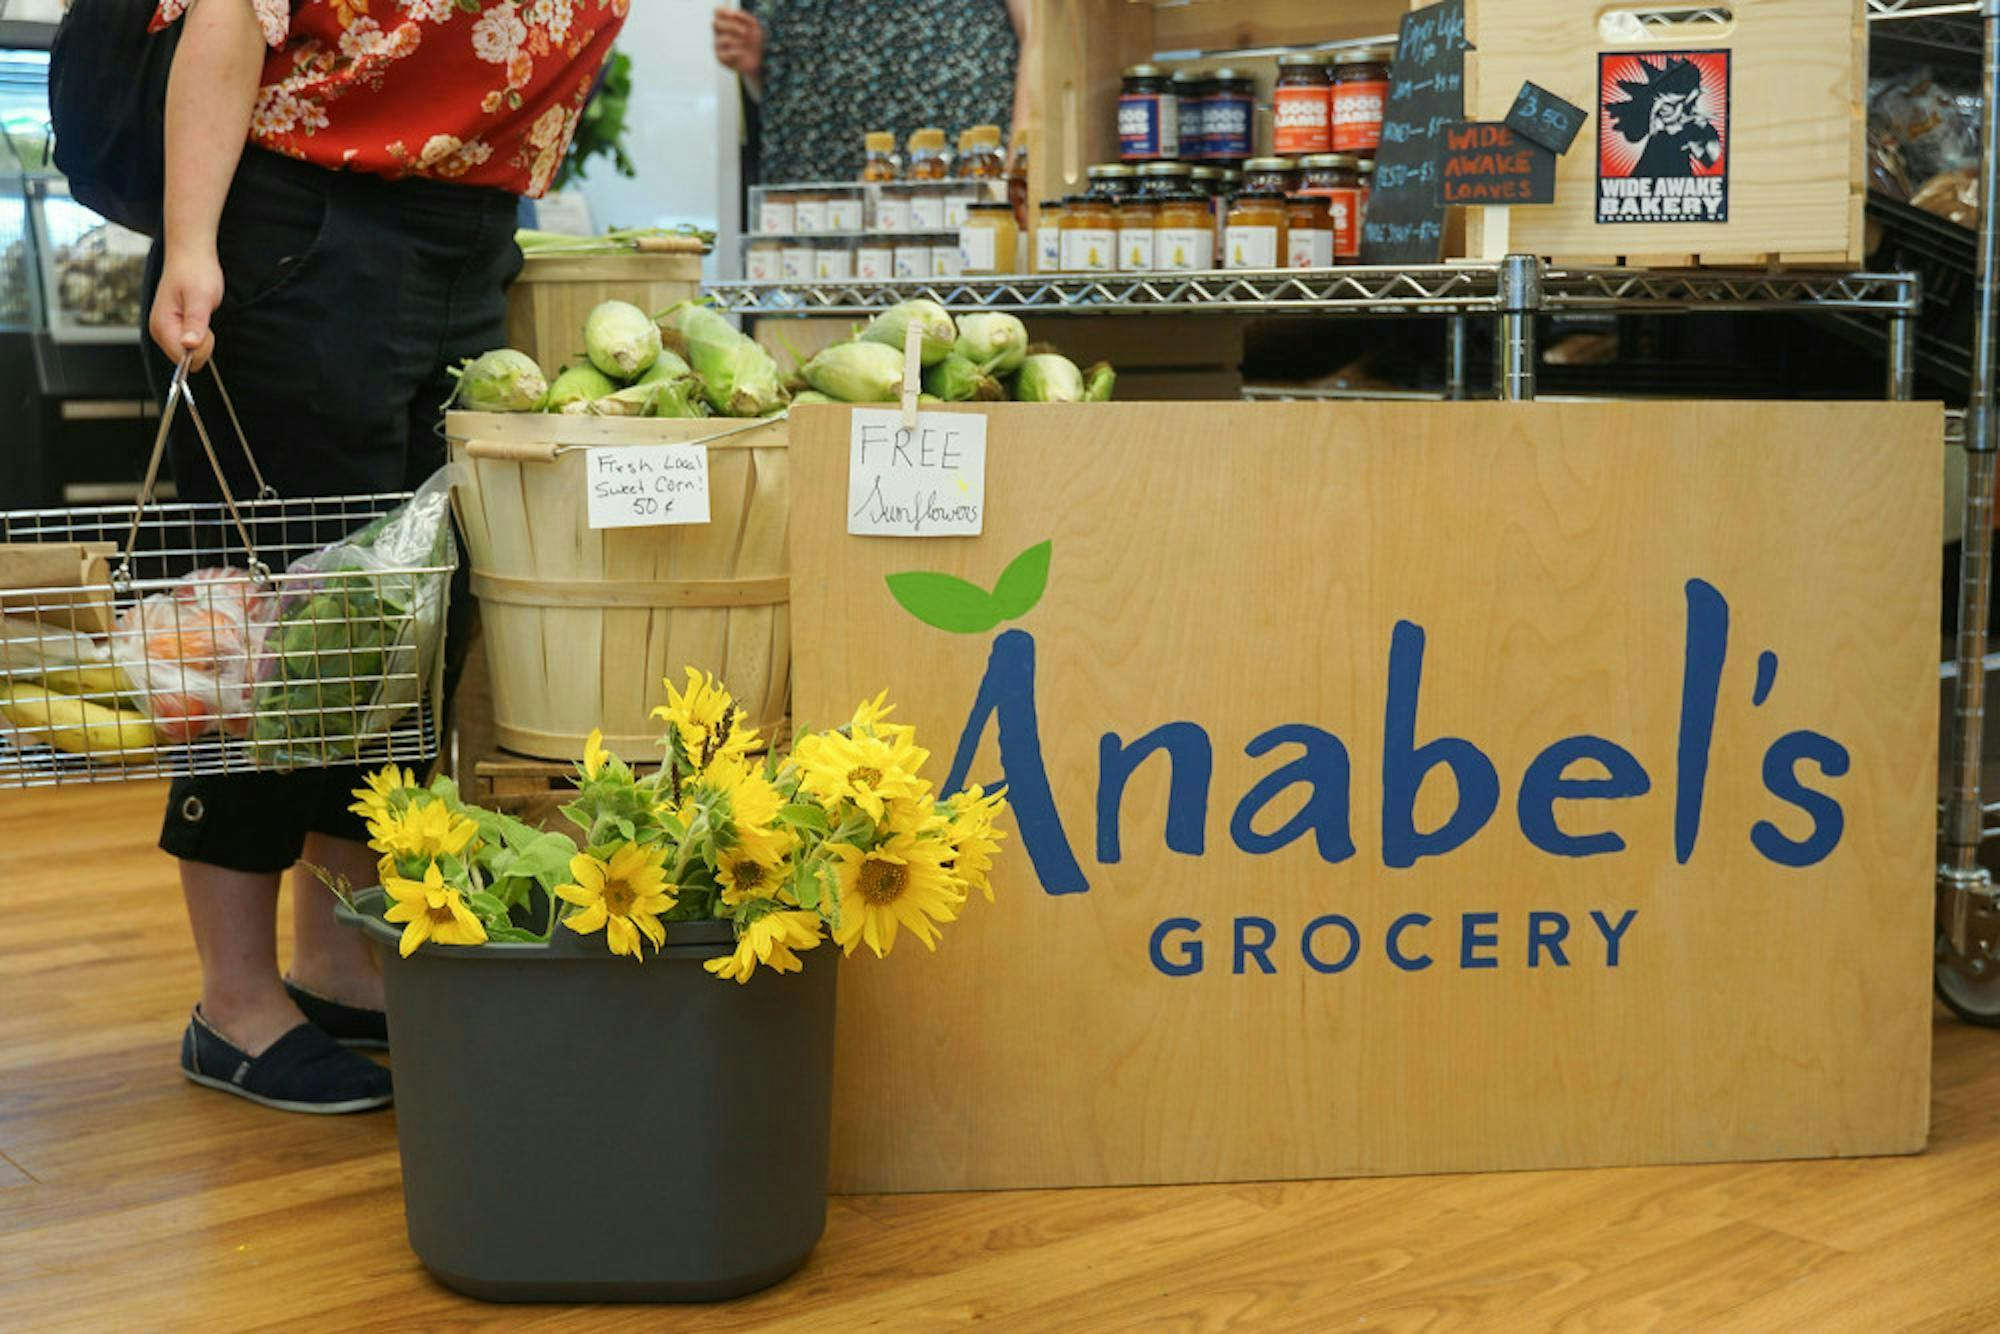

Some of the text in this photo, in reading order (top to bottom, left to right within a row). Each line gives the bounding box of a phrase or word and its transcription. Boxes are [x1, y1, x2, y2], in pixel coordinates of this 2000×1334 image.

[1448, 126, 1515, 151] WIDE
[1444, 150, 1534, 177] AWAKE
[1444, 180, 1532, 201] LOAVES
[1601, 177, 1723, 197] WIDE AWAKE
[1600, 196, 1723, 215] BAKERY
[861, 424, 962, 468] FREE
[597, 453, 653, 474] Fresh
[594, 479, 644, 499] Sweet
[853, 474, 978, 531] Sunflowers
[938, 577, 1850, 896] Anabel's
[1149, 909, 1640, 977] GROCERY
